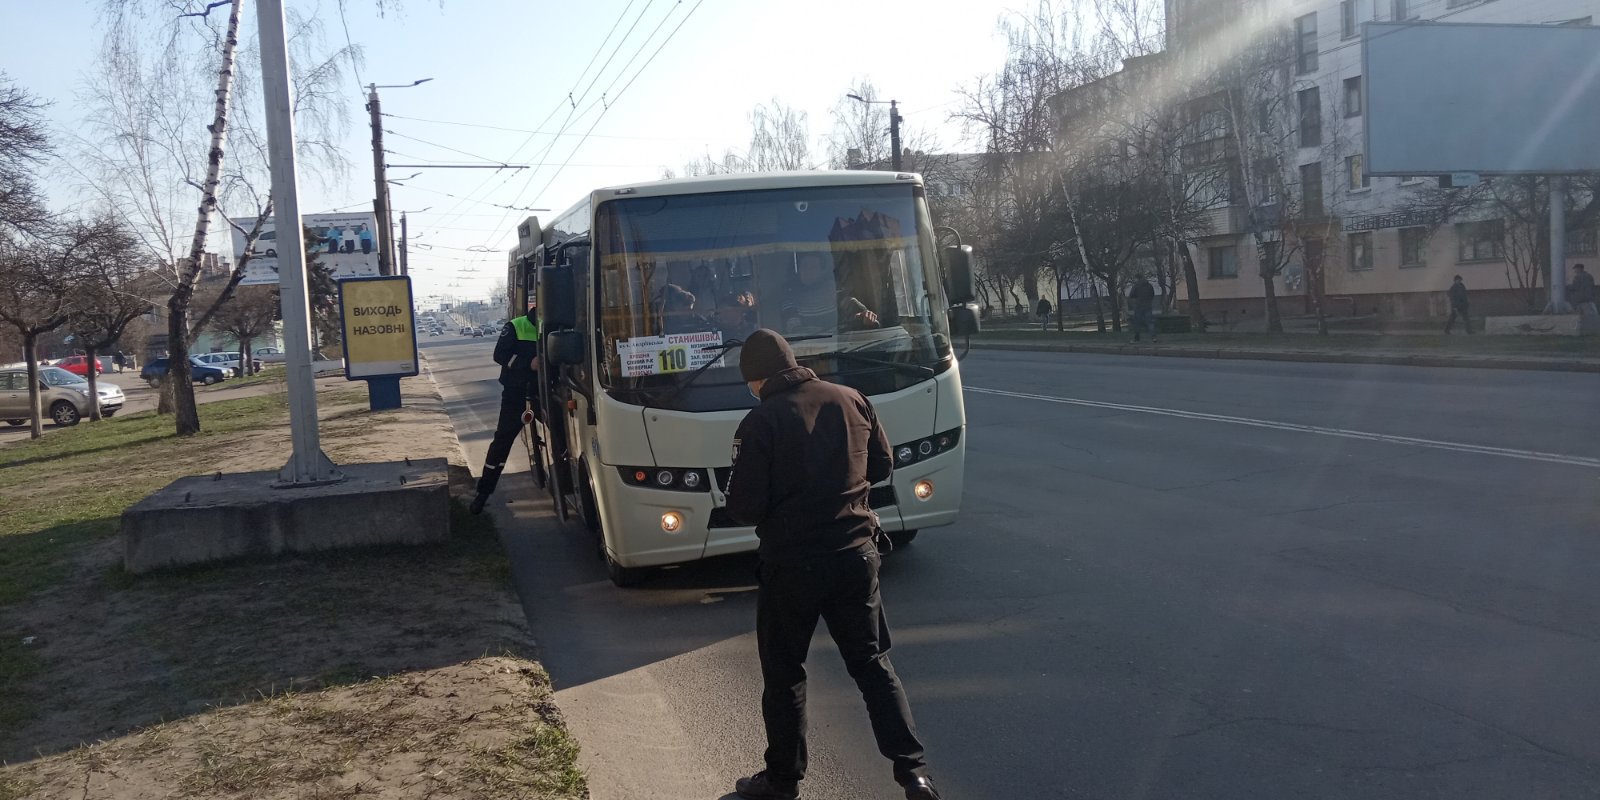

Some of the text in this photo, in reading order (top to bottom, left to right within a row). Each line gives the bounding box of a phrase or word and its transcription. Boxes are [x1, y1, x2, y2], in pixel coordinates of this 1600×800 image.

[353, 305, 402, 317] ВИХОДЬ
[353, 324, 405, 335] НАЗОВНІ
[668, 333, 720, 344] СТАНИШІВКА
[659, 348, 687, 370] 110
